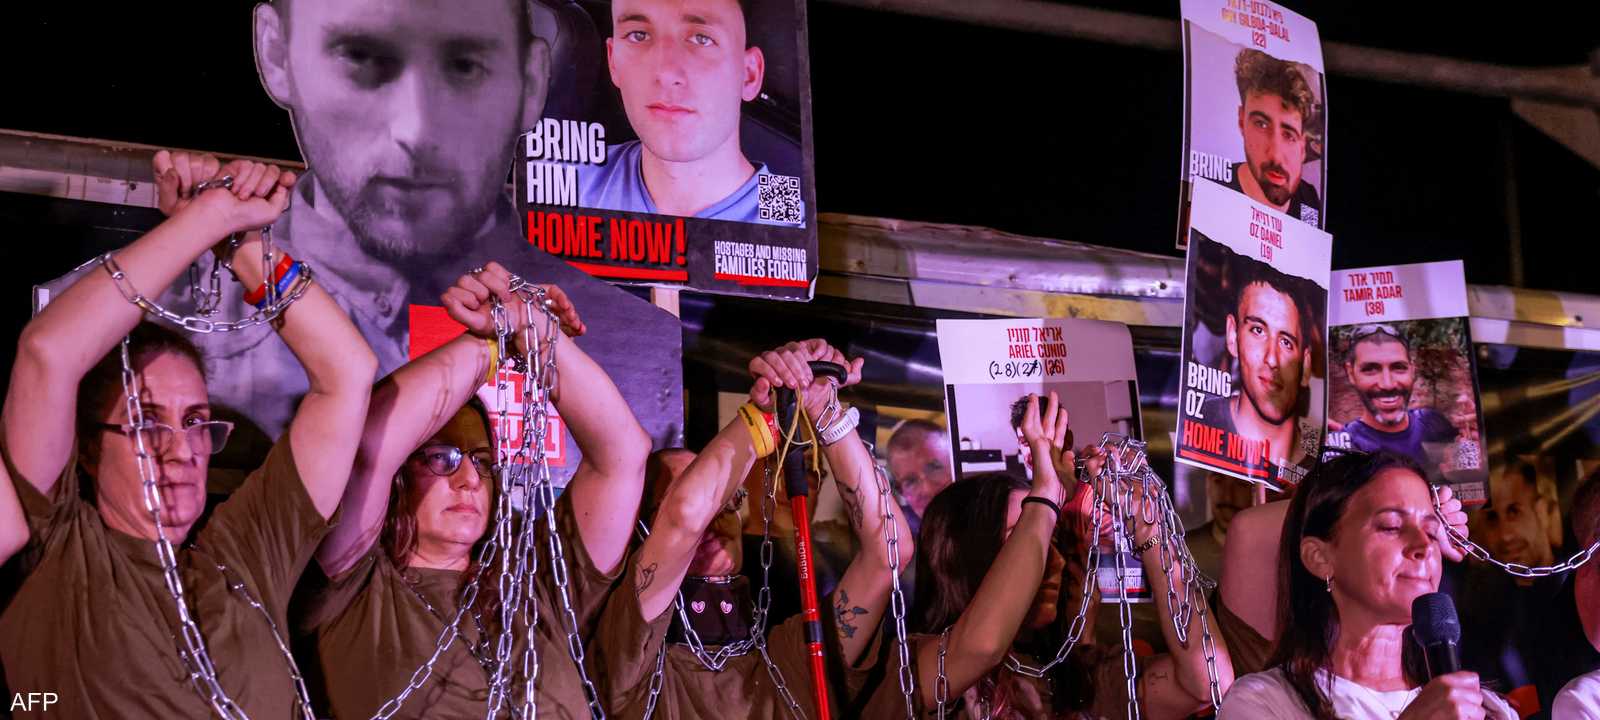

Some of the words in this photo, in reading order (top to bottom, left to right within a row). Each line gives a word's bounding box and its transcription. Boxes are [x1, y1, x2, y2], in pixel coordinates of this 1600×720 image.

[1252, 30, 1266, 48] (22)
[527, 118, 606, 164] BRING
[1191, 151, 1232, 183] BRING
[527, 161, 577, 207] HIM
[527, 211, 604, 258] HOME
[610, 218, 687, 266] NOW!
[1249, 223, 1260, 239] OZ
[1260, 226, 1283, 249] DANIEL
[714, 240, 754, 258] HOSTAGES
[755, 244, 771, 260] AND
[772, 246, 807, 263] MISSING
[715, 255, 765, 278] FAMILIES
[767, 259, 808, 283] FORUM
[1343, 287, 1374, 302] TAMIR
[1376, 285, 1403, 300] ADAR
[1364, 300, 1385, 317] (38)
[1007, 327, 1030, 344] קוניו
[1032, 326, 1063, 342] אריאל
[1009, 344, 1036, 359] ARIEL
[1037, 343, 1067, 359] CUNIO
[1187, 361, 1232, 398] BRING
[1185, 389, 1206, 419] OZ
[1183, 419, 1225, 456] HOME
[1227, 431, 1271, 468] NOW!
